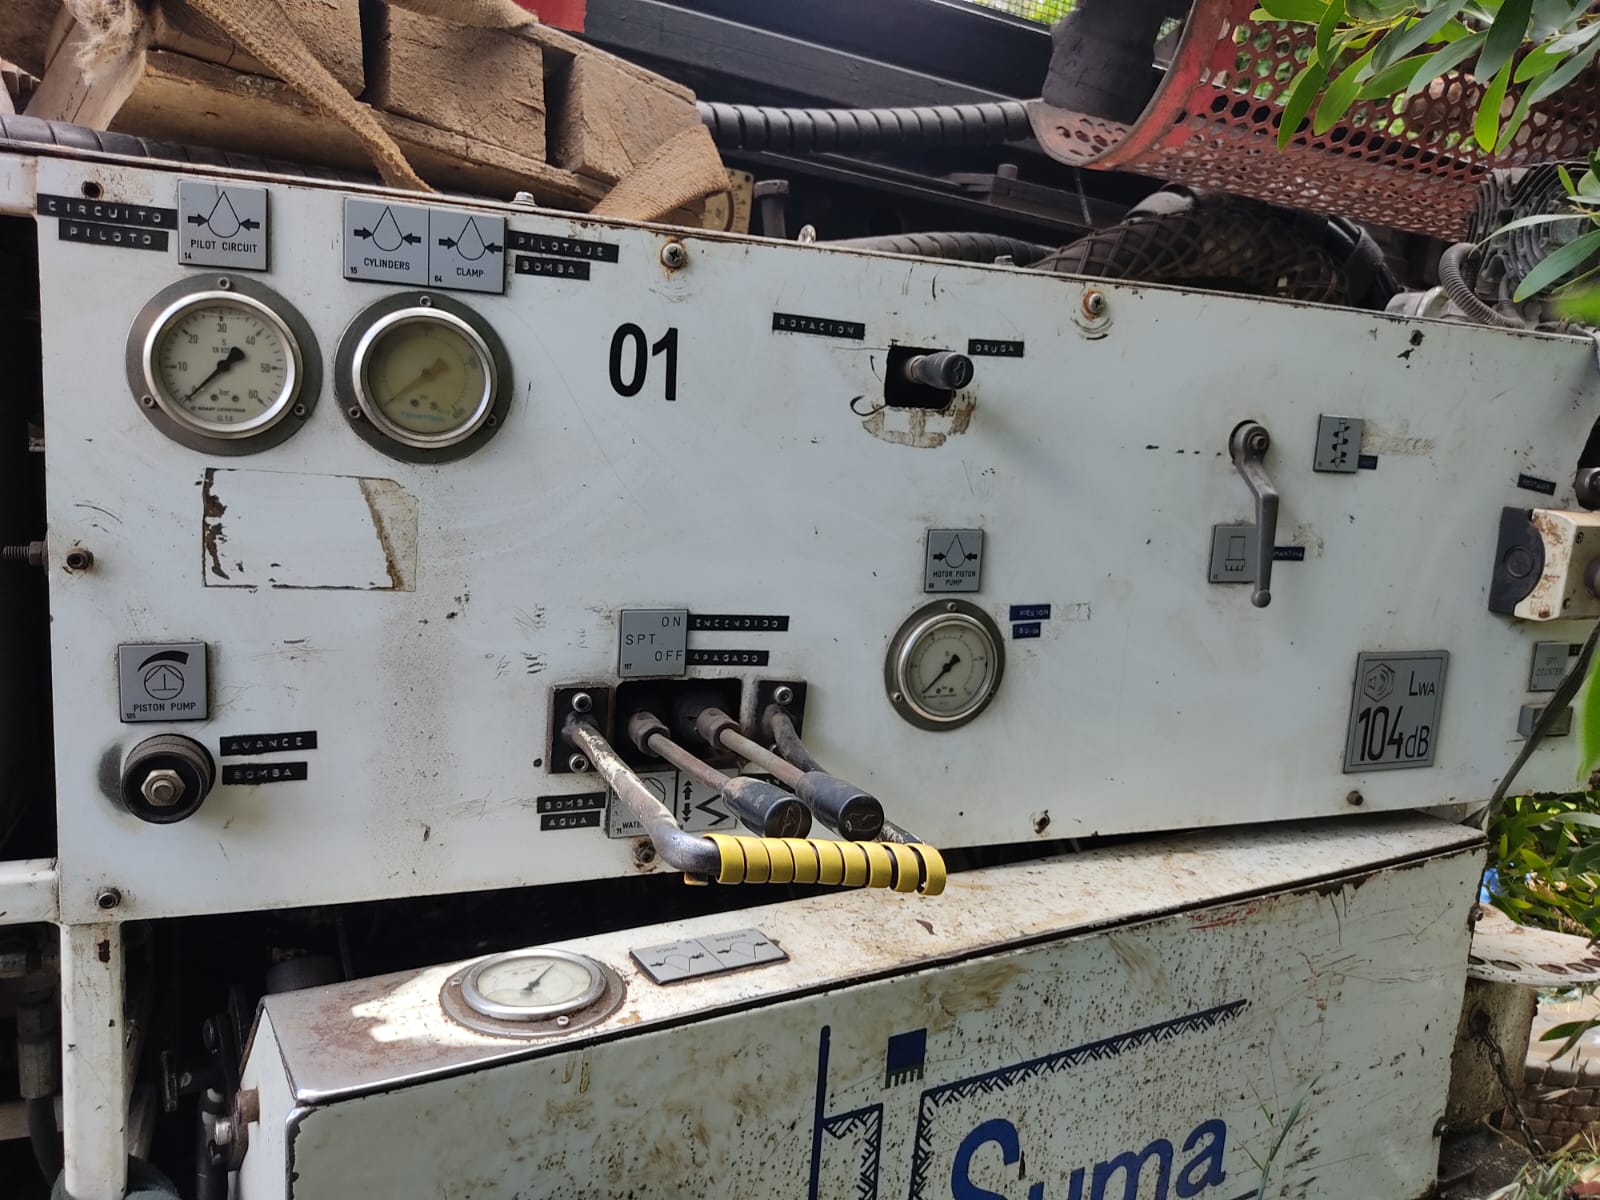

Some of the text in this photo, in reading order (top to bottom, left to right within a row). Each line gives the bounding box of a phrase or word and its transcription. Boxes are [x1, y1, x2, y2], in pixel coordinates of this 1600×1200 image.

[48, 200, 162, 223] CIRCUITO
[69, 226, 152, 245] PILOTO
[190, 239, 257, 254] PILOT CIRCUIT
[519, 236, 604, 257] PILOTAJE
[184, 251, 193, 260] 14
[363, 257, 411, 271] CYLINDERS
[522, 260, 577, 275] BOMBA
[456, 266, 484, 278] CLAMP
[216, 323, 227, 333] 30
[779, 318, 855, 335] ROTACION
[188, 334, 198, 344] 20
[245, 335, 256, 345] 40
[975, 344, 1016, 353] ORUGA
[178, 362, 187, 371] 10
[608, 322, 678, 402] 01
[260, 364, 271, 373] 50
[248, 390, 258, 399] 60
[933, 570, 976, 578] MOTOR PISTON
[945, 578, 962, 586] PUMP
[661, 616, 681, 627] ON
[695, 619, 778, 628] ENCENDIDO
[625, 633, 656, 646] SPT
[654, 650, 683, 662] OFF
[693, 652, 758, 662] APAGADO
[133, 702, 196, 713] PISTON PUMP
[231, 737, 303, 750] AVANCE
[234, 768, 292, 779] BOMBA
[544, 798, 595, 810] BOMBA
[548, 816, 588, 826] AGUA
[622, 821, 644, 830] WATE
